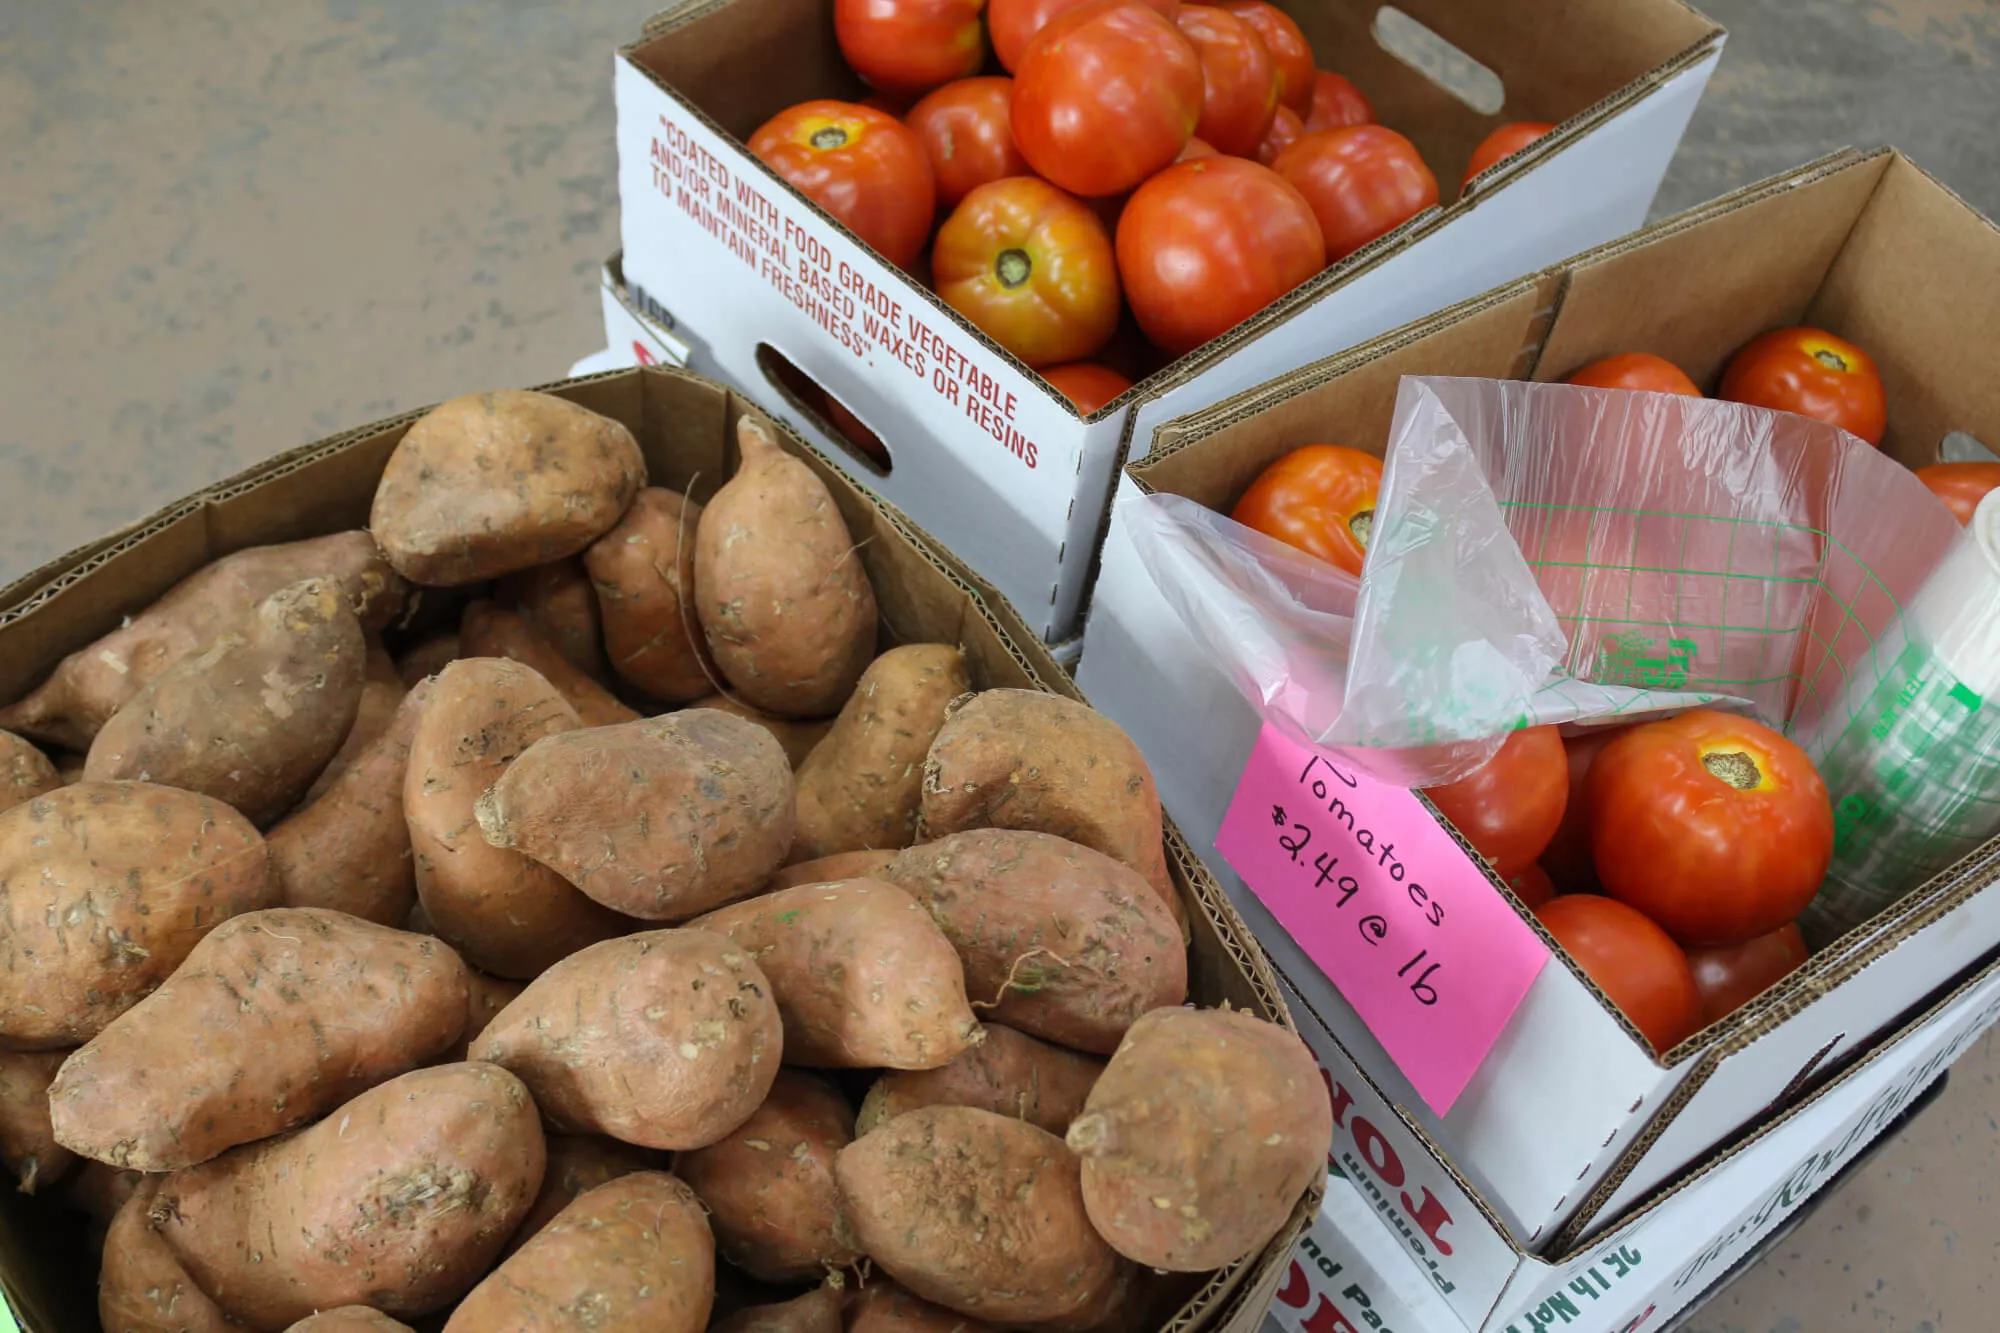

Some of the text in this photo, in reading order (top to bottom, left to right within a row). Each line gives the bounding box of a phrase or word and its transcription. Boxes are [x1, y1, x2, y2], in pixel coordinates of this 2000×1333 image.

[651, 162, 672, 198] TO
[677, 185, 756, 268] MAINTAIN
[651, 136, 1038, 469] AND/OR MINERAL BASED WAXES OR RESINS
[659, 114, 1018, 421] "COATED WITH FOOD GRADE VEGETABLE
[1272, 804, 1442, 1007] $2.49 @ lb
[1299, 755, 1445, 927] Tomatoes
[1342, 1153, 1456, 1294] Premium
